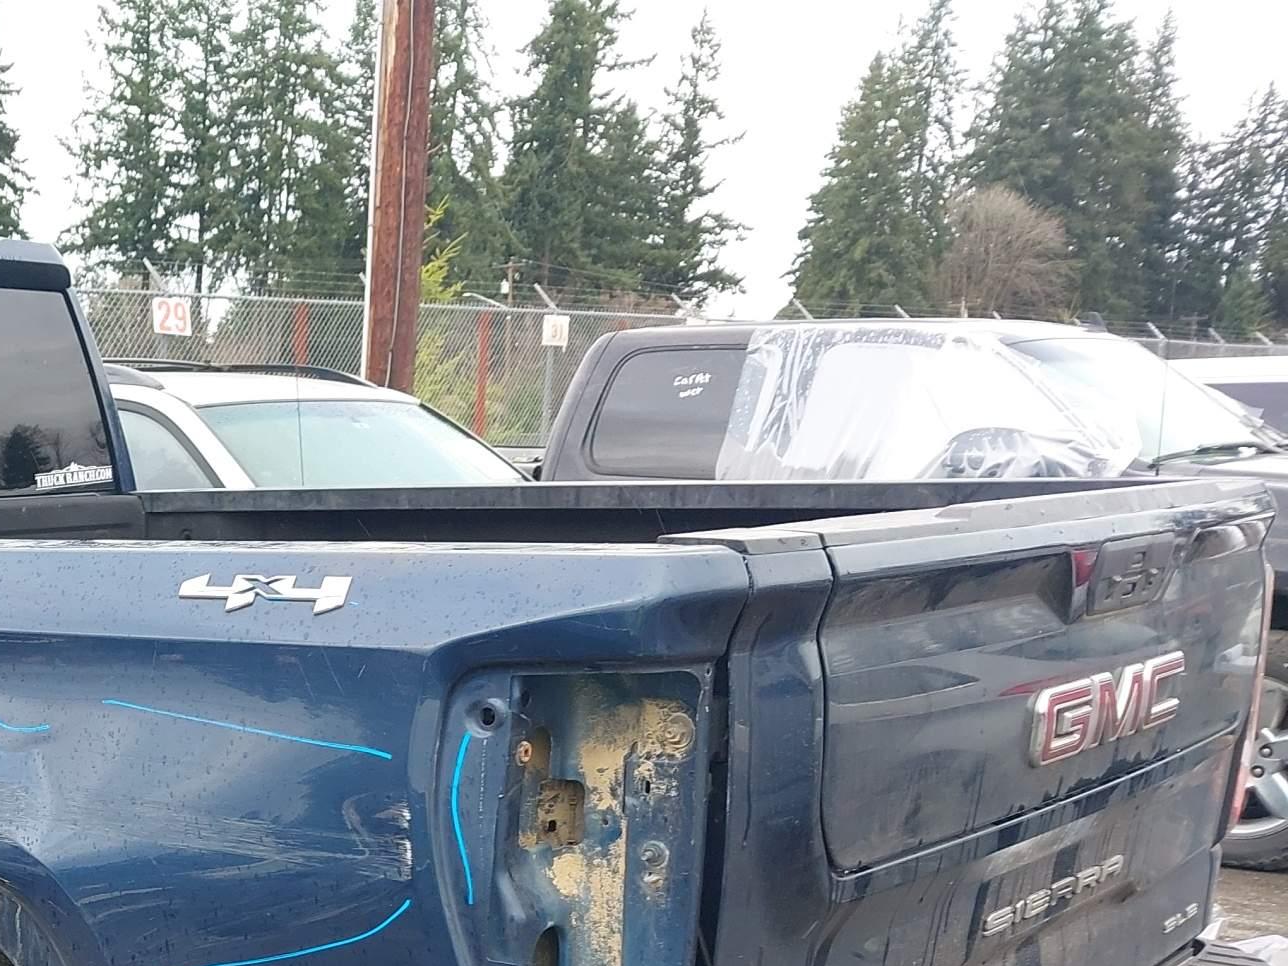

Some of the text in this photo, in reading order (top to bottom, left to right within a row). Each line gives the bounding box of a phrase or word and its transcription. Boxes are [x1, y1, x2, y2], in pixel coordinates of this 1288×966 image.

[157, 299, 187, 333] 29
[1030, 650, 1185, 767] GMC
[982, 854, 1124, 937] SIERRA
